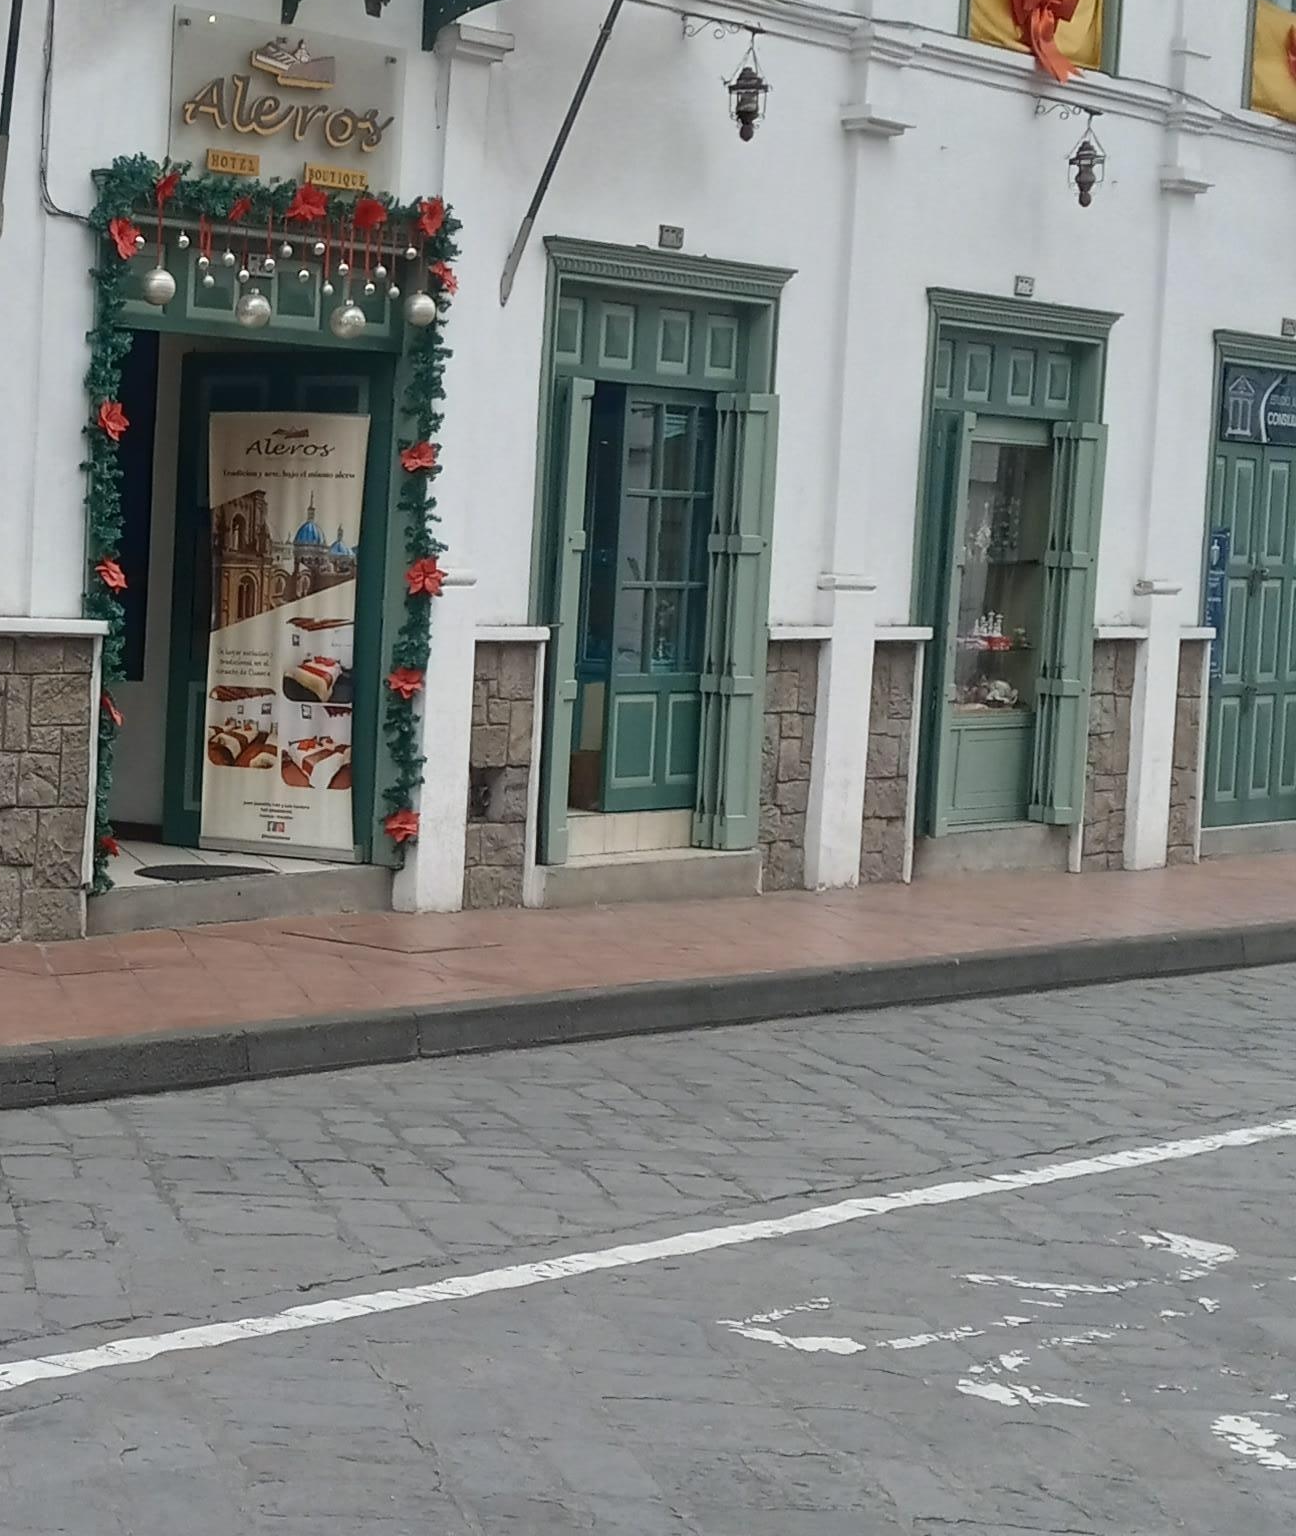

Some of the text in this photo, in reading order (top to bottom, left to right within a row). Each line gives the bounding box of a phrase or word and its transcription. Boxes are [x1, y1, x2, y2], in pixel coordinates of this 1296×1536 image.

[183, 74, 395, 153] Aleros
[211, 155, 366, 188] HOTEL BOUTIQUE
[245, 438, 336, 457] Aleros
